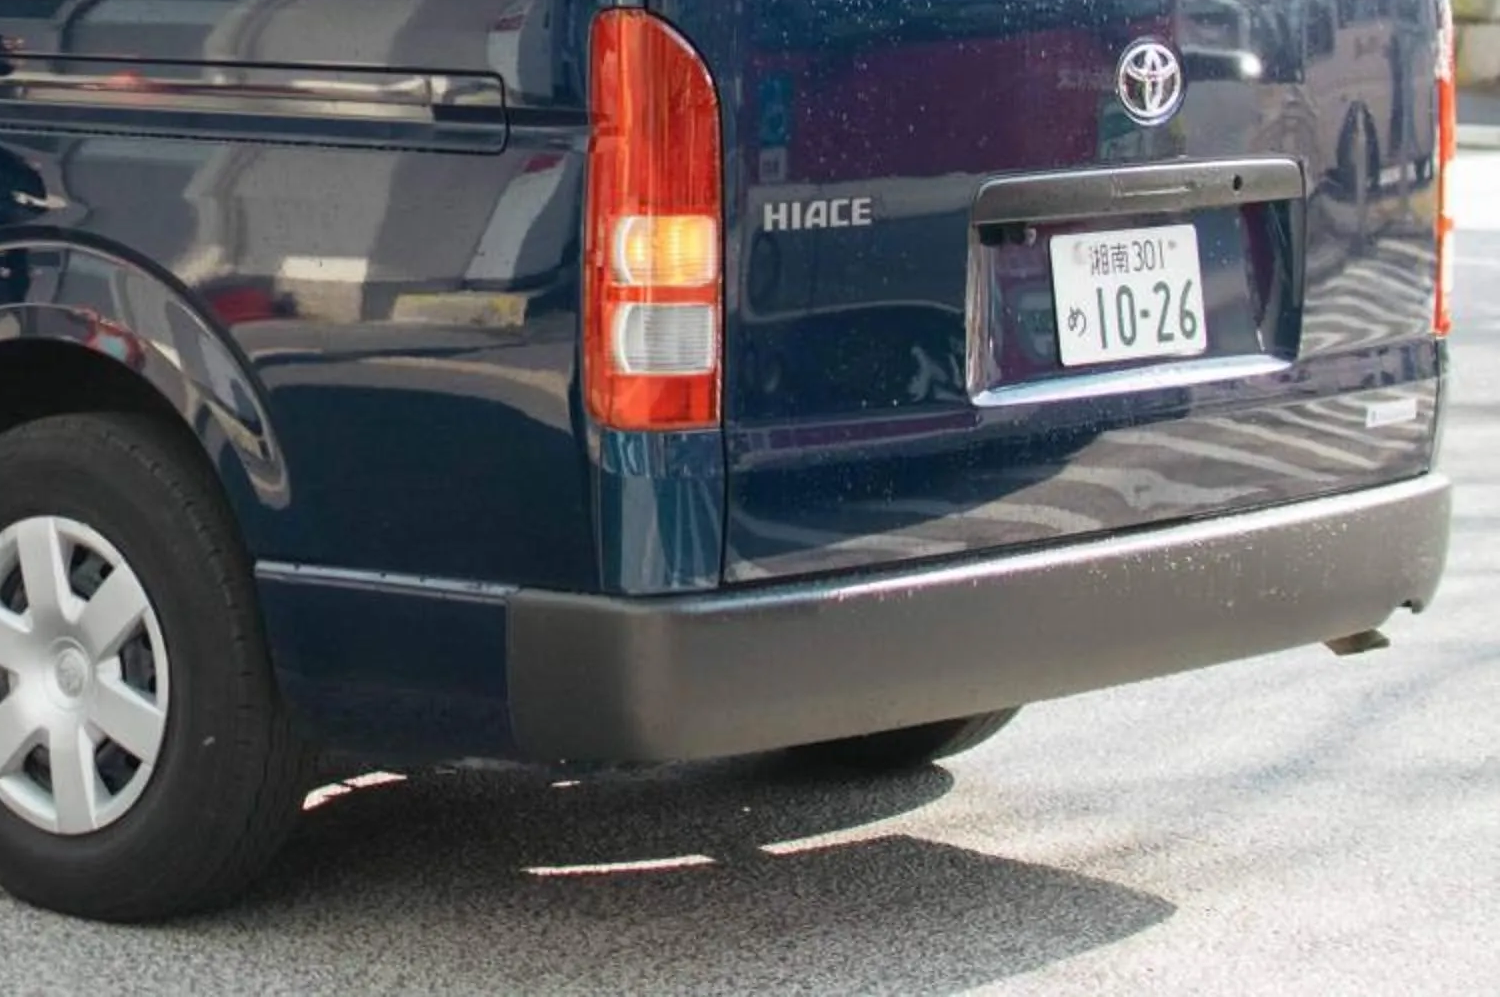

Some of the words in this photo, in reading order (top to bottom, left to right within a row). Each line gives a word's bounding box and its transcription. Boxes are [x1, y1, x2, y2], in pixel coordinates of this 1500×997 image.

[763, 197, 872, 232] HIACE
[1067, 306, 1088, 338] め
[1096, 278, 1198, 350] 10-26
